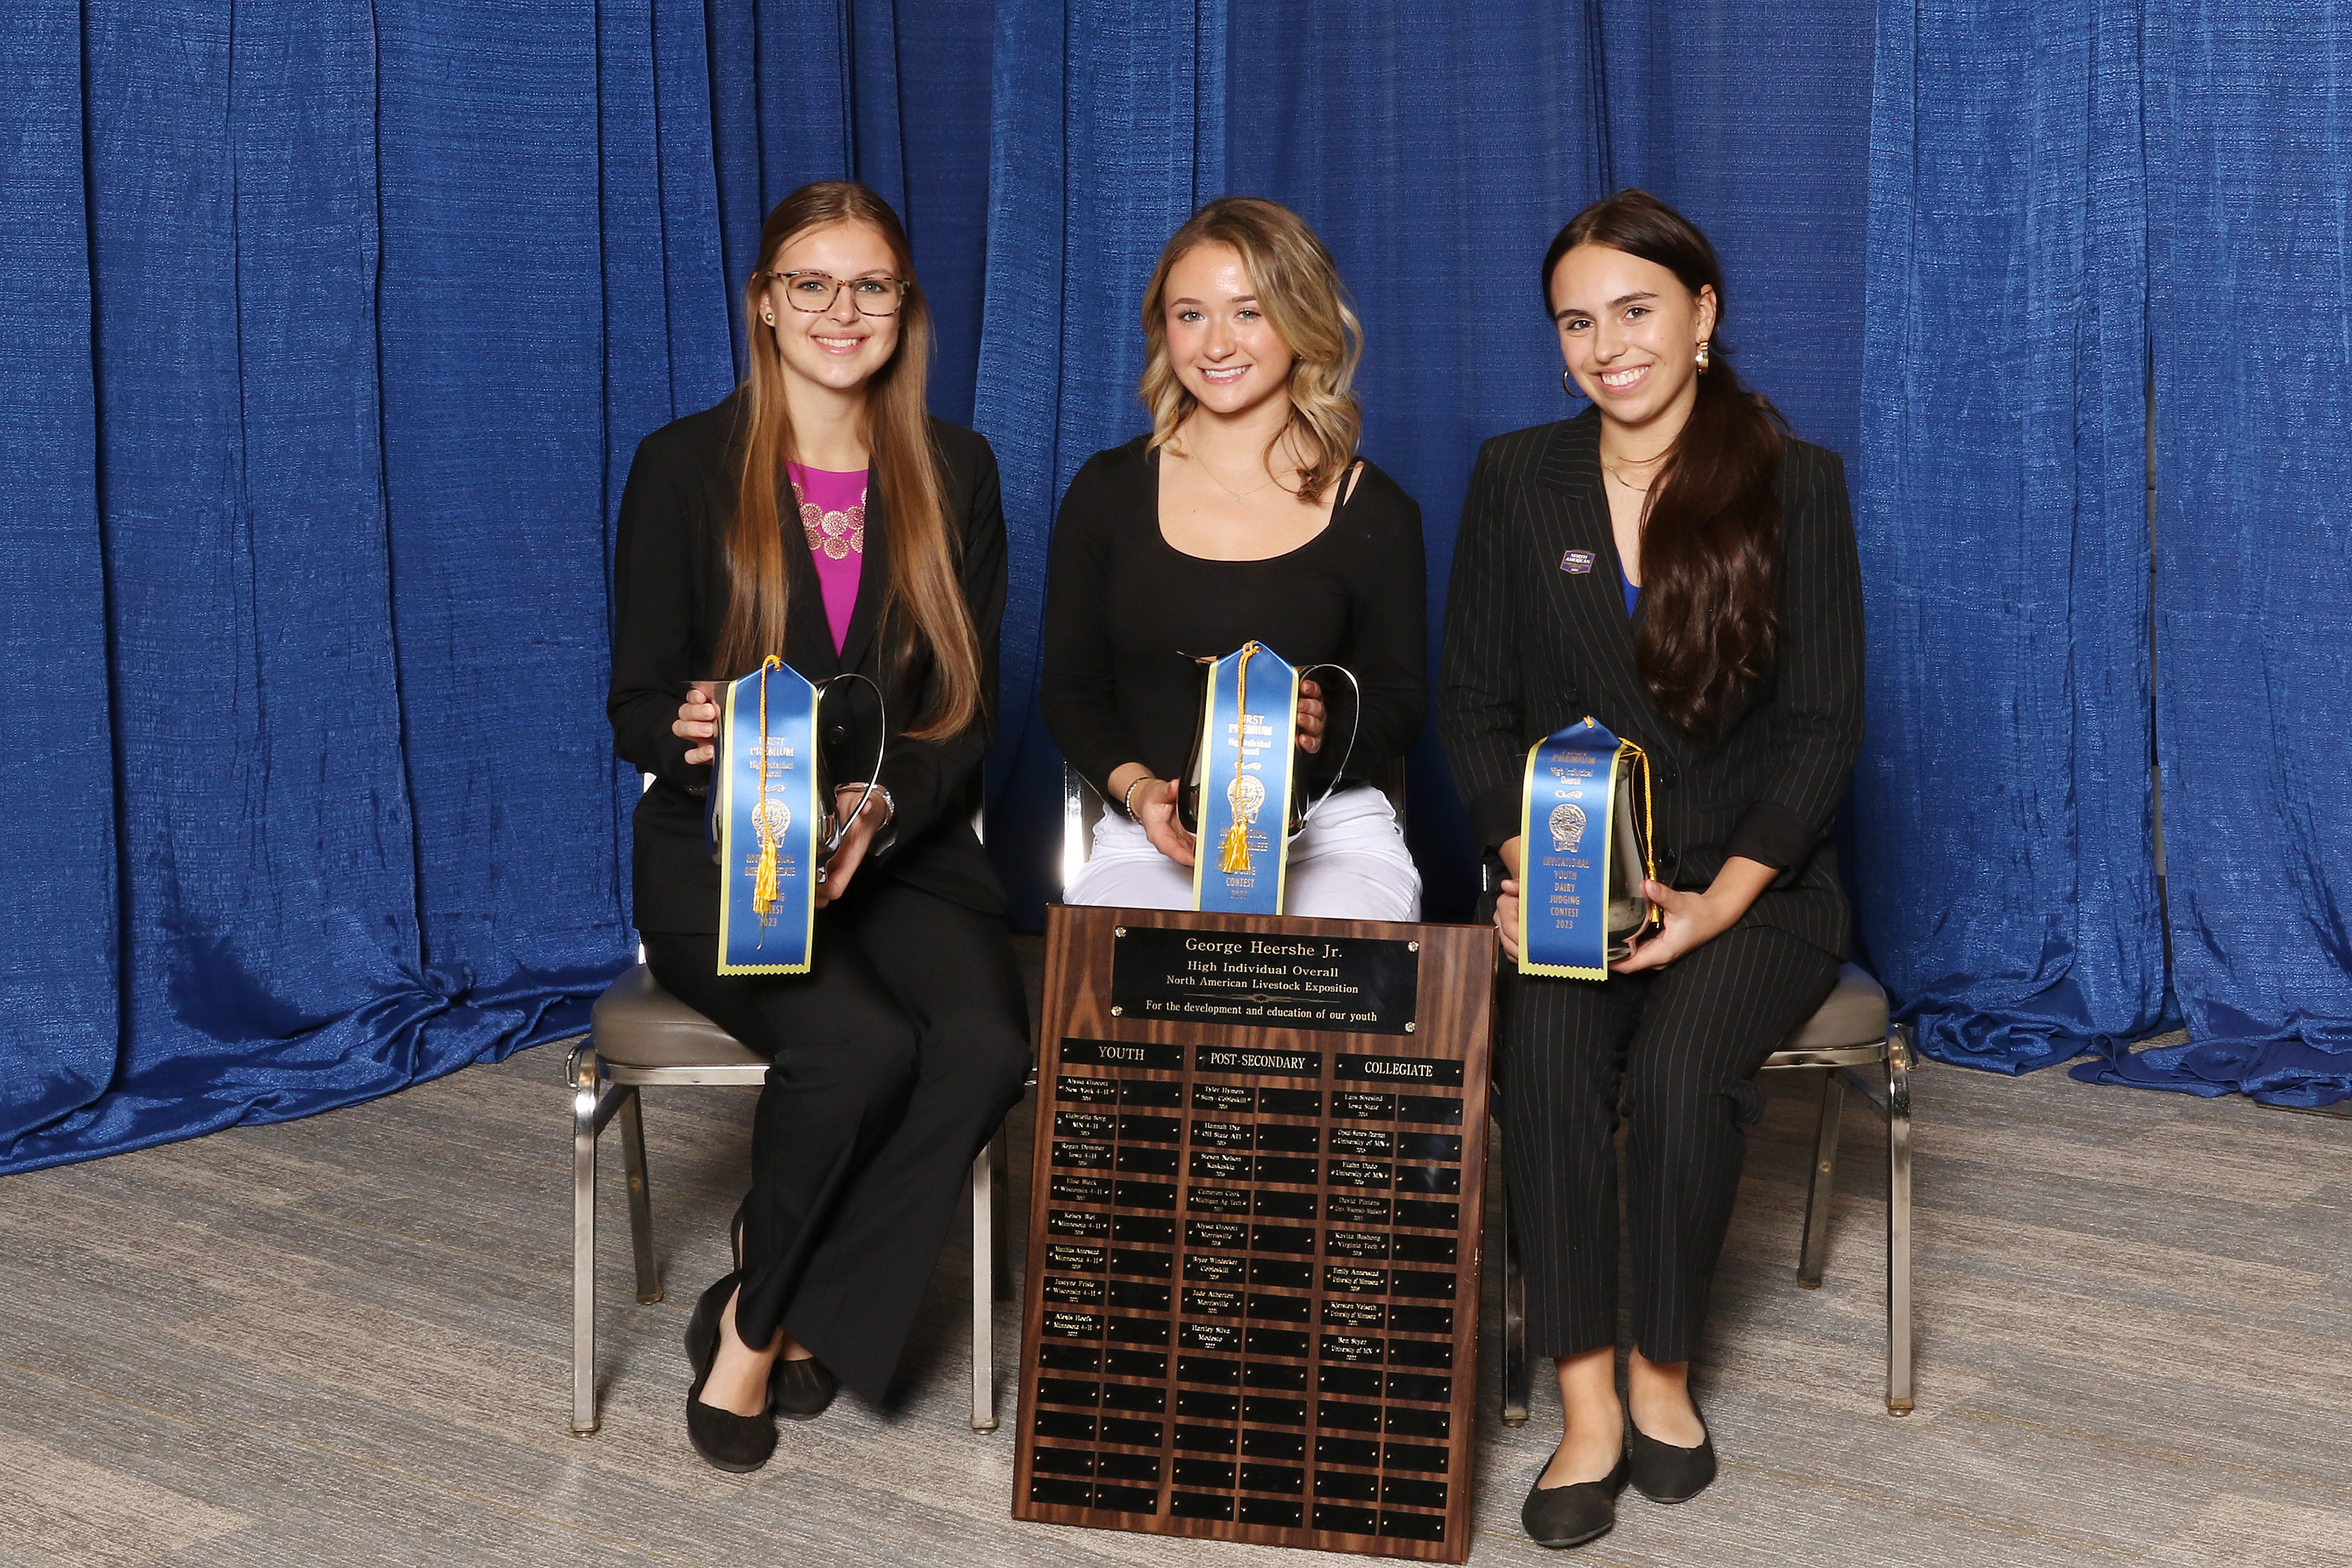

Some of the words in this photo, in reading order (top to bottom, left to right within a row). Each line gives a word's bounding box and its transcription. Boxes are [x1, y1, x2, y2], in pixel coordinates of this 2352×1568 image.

[1243, 738, 1272, 748] Individual
[1552, 755, 1595, 764] PREMIUM
[1566, 768, 1593, 777] Individual
[1561, 776, 1581, 785] Overall
[1543, 857, 1589, 868] INVITATIONAL
[1554, 870, 1577, 880] YOUTH
[1226, 877, 1254, 887] CONTEST
[1555, 883, 1575, 892] DAIRY
[1550, 895, 1580, 905] JUDGING
[1550, 907, 1579, 917] CONTEST
[1556, 920, 1573, 928] 2023
[1185, 938, 1242, 955] George
[1250, 941, 1315, 956] Heershe
[1322, 944, 1343, 959] Jr.
[1187, 961, 1217, 972] High
[1223, 962, 1286, 975] Individual
[1292, 966, 1338, 977] Overall
[1166, 975, 1195, 985] North
[1200, 978, 1247, 988] American
[1252, 980, 1300, 991] Livestock
[1305, 983, 1358, 994] Exposition
[1146, 1000, 1162, 1010] For
[1166, 1002, 1181, 1011] the
[1184, 1003, 1242, 1015] development
[1246, 1006, 1263, 1015] and
[1267, 1007, 1312, 1018] education
[1316, 1009, 1326, 1019] of
[1330, 1011, 1345, 1020] our
[1349, 1010, 1377, 1022] youth
[1098, 1046, 1145, 1061] YOUTH
[1210, 1053, 1306, 1070] POST-SECONDARY
[1364, 1061, 1433, 1077] COLLEGIATE
[1336, 1169, 1362, 1178] University
[1192, 1324, 1213, 1333] Hartley
[1331, 1345, 1354, 1354] University
